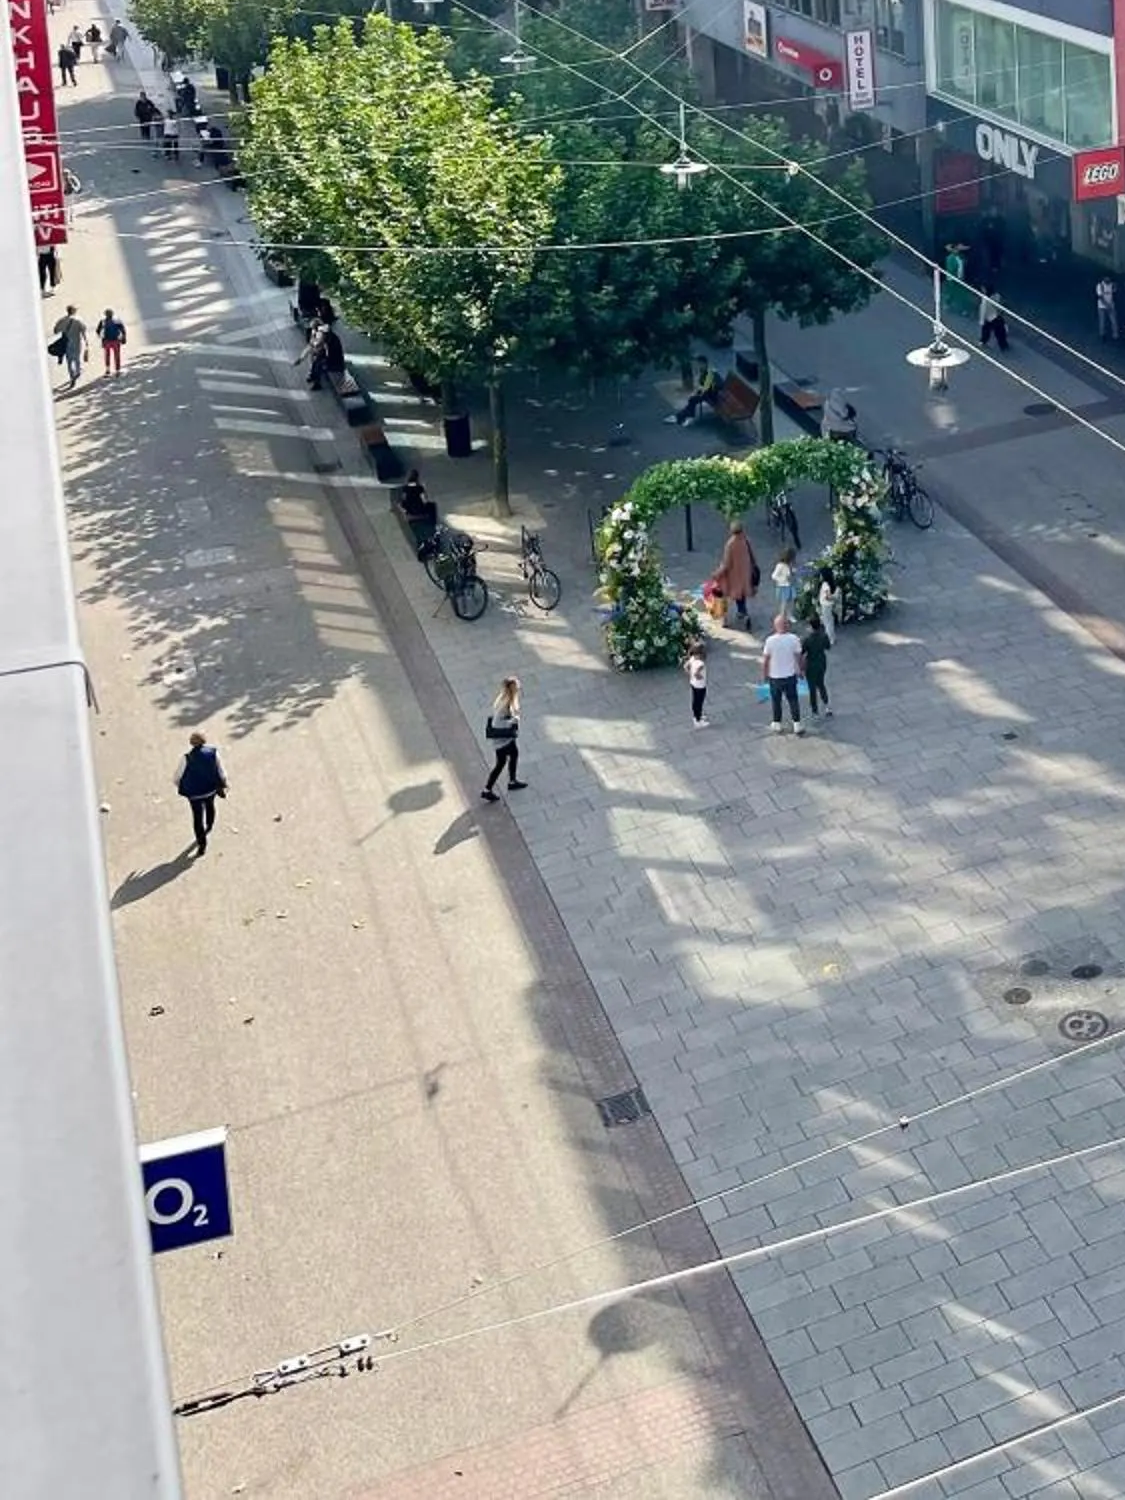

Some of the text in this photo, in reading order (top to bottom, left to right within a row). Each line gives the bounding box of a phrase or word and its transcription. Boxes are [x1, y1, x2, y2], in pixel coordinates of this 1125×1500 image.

[853, 35, 866, 90] HOTEL
[975, 123, 1039, 179] ONLY
[1083, 161, 1120, 185] LEGO
